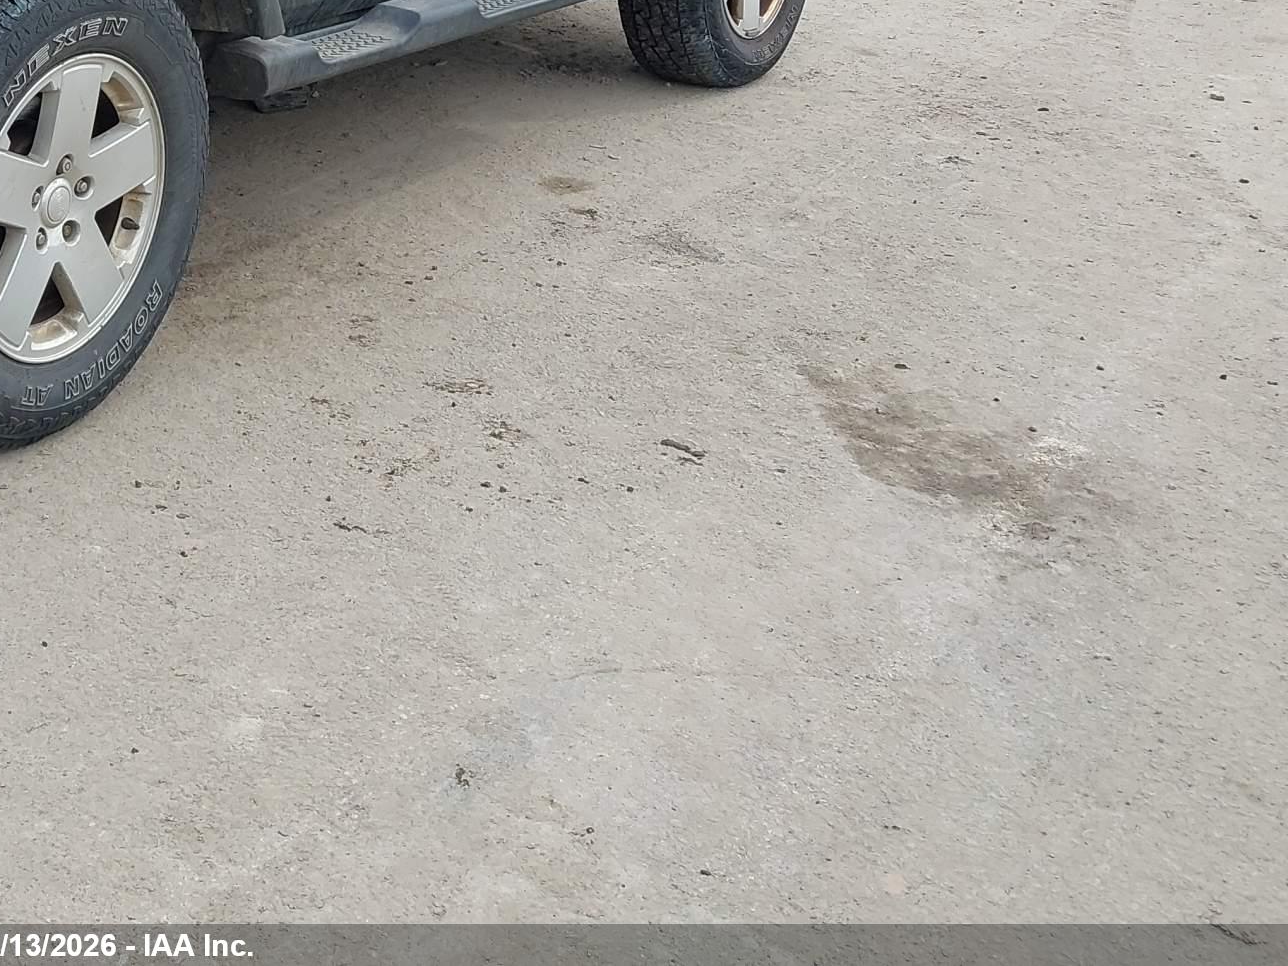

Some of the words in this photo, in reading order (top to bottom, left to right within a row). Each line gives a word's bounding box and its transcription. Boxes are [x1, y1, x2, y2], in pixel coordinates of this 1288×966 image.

[2, 16, 129, 108] NEXEN
[64, 280, 163, 401] ROADIAN
[20, 383, 55, 407] AT
